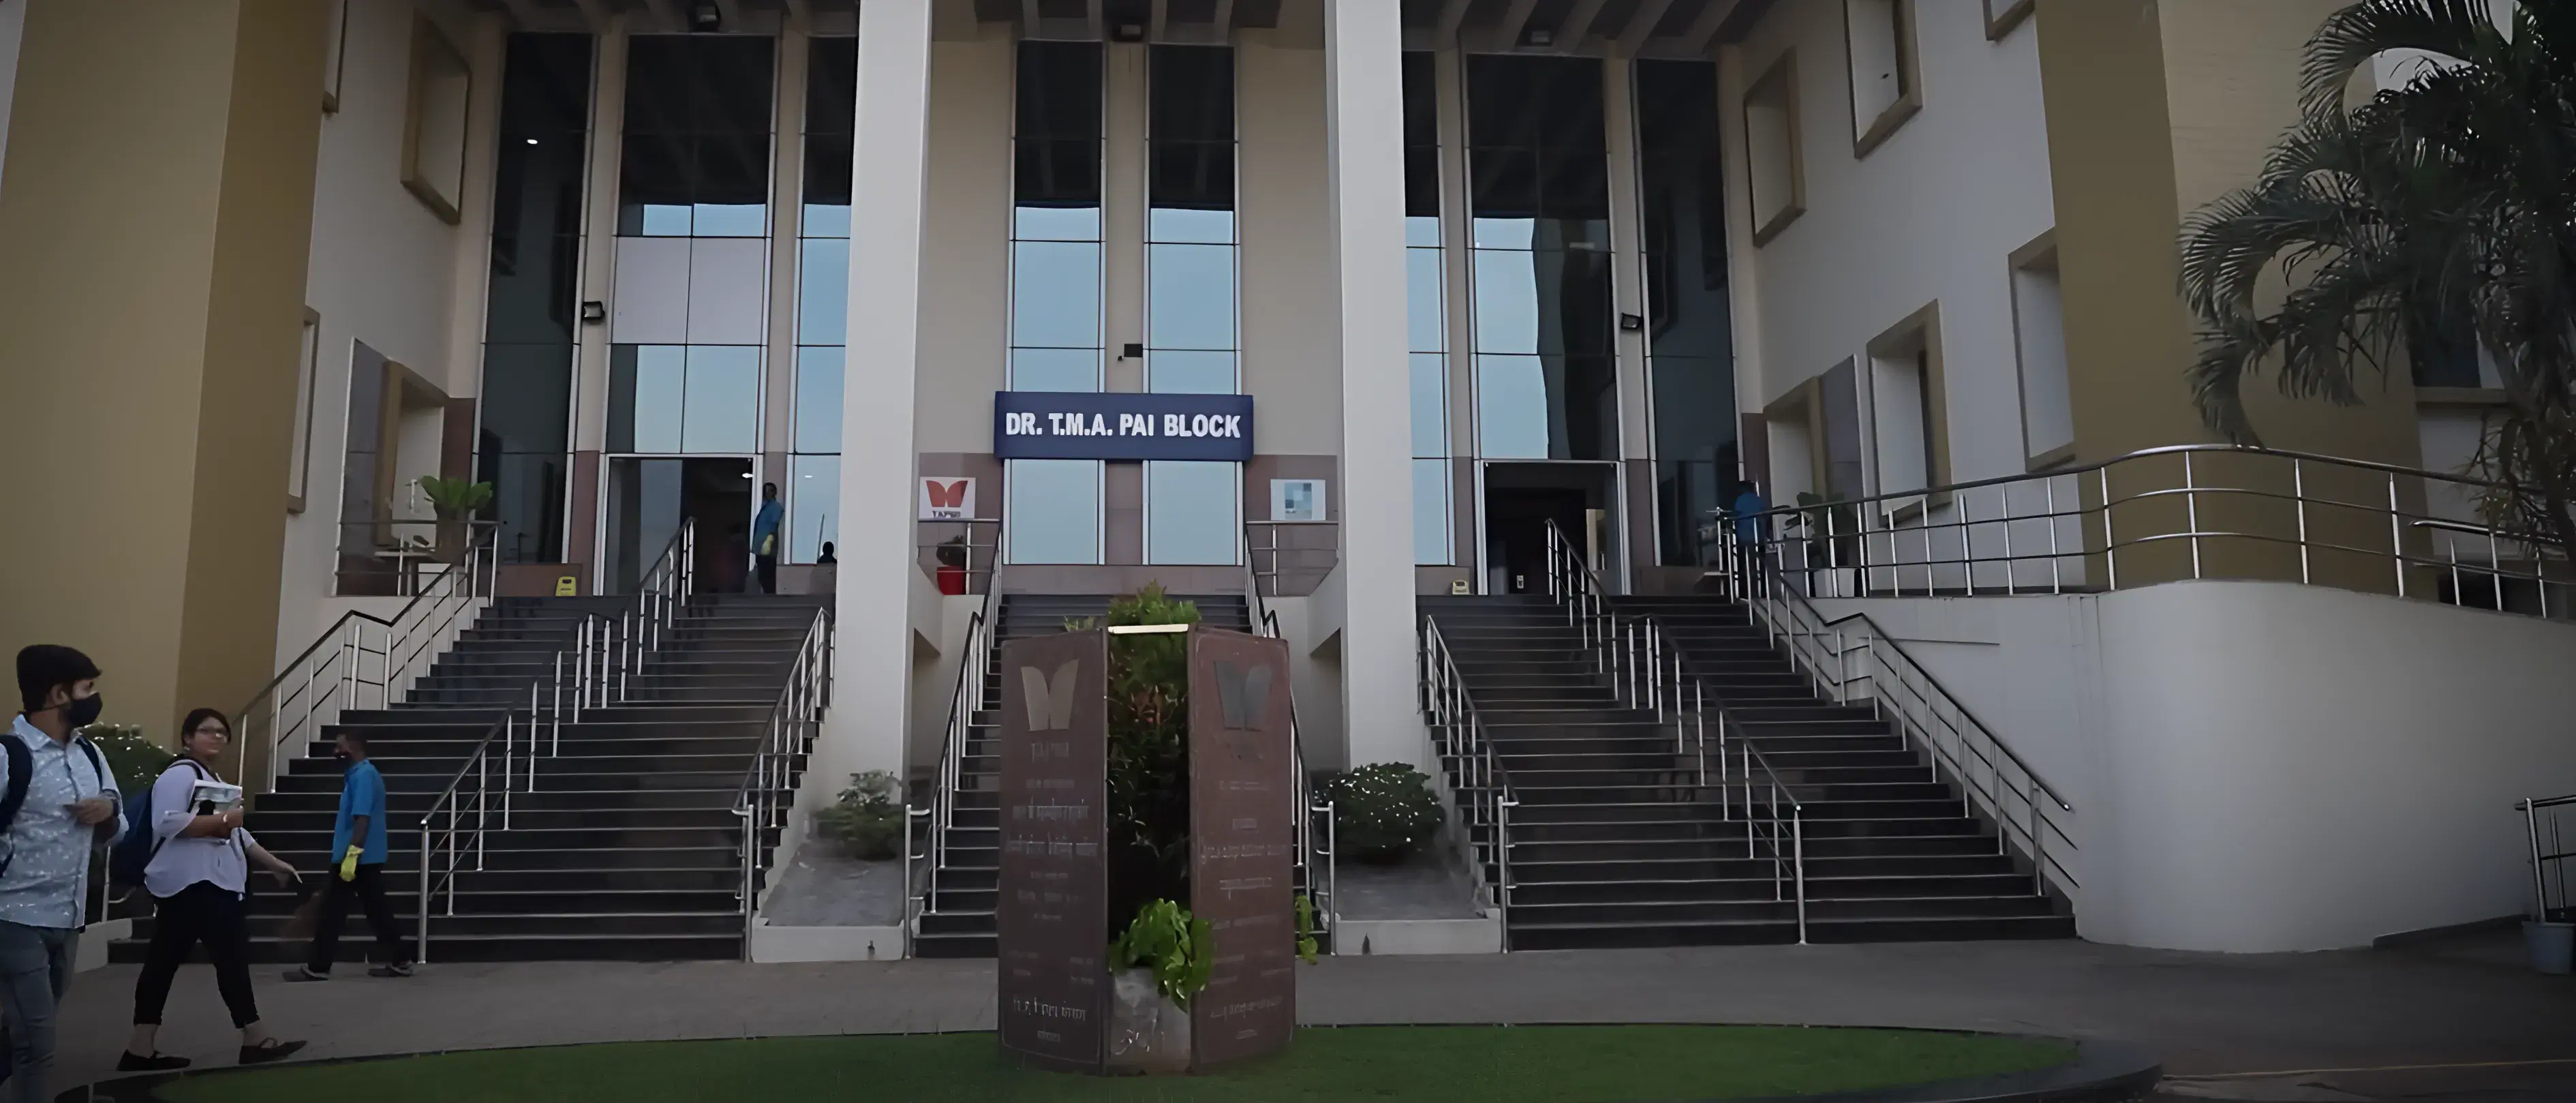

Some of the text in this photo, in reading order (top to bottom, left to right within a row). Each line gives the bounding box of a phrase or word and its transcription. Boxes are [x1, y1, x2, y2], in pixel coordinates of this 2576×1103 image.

[1006, 412, 1241, 438] DR. T.M.A. PAI BLOCK
